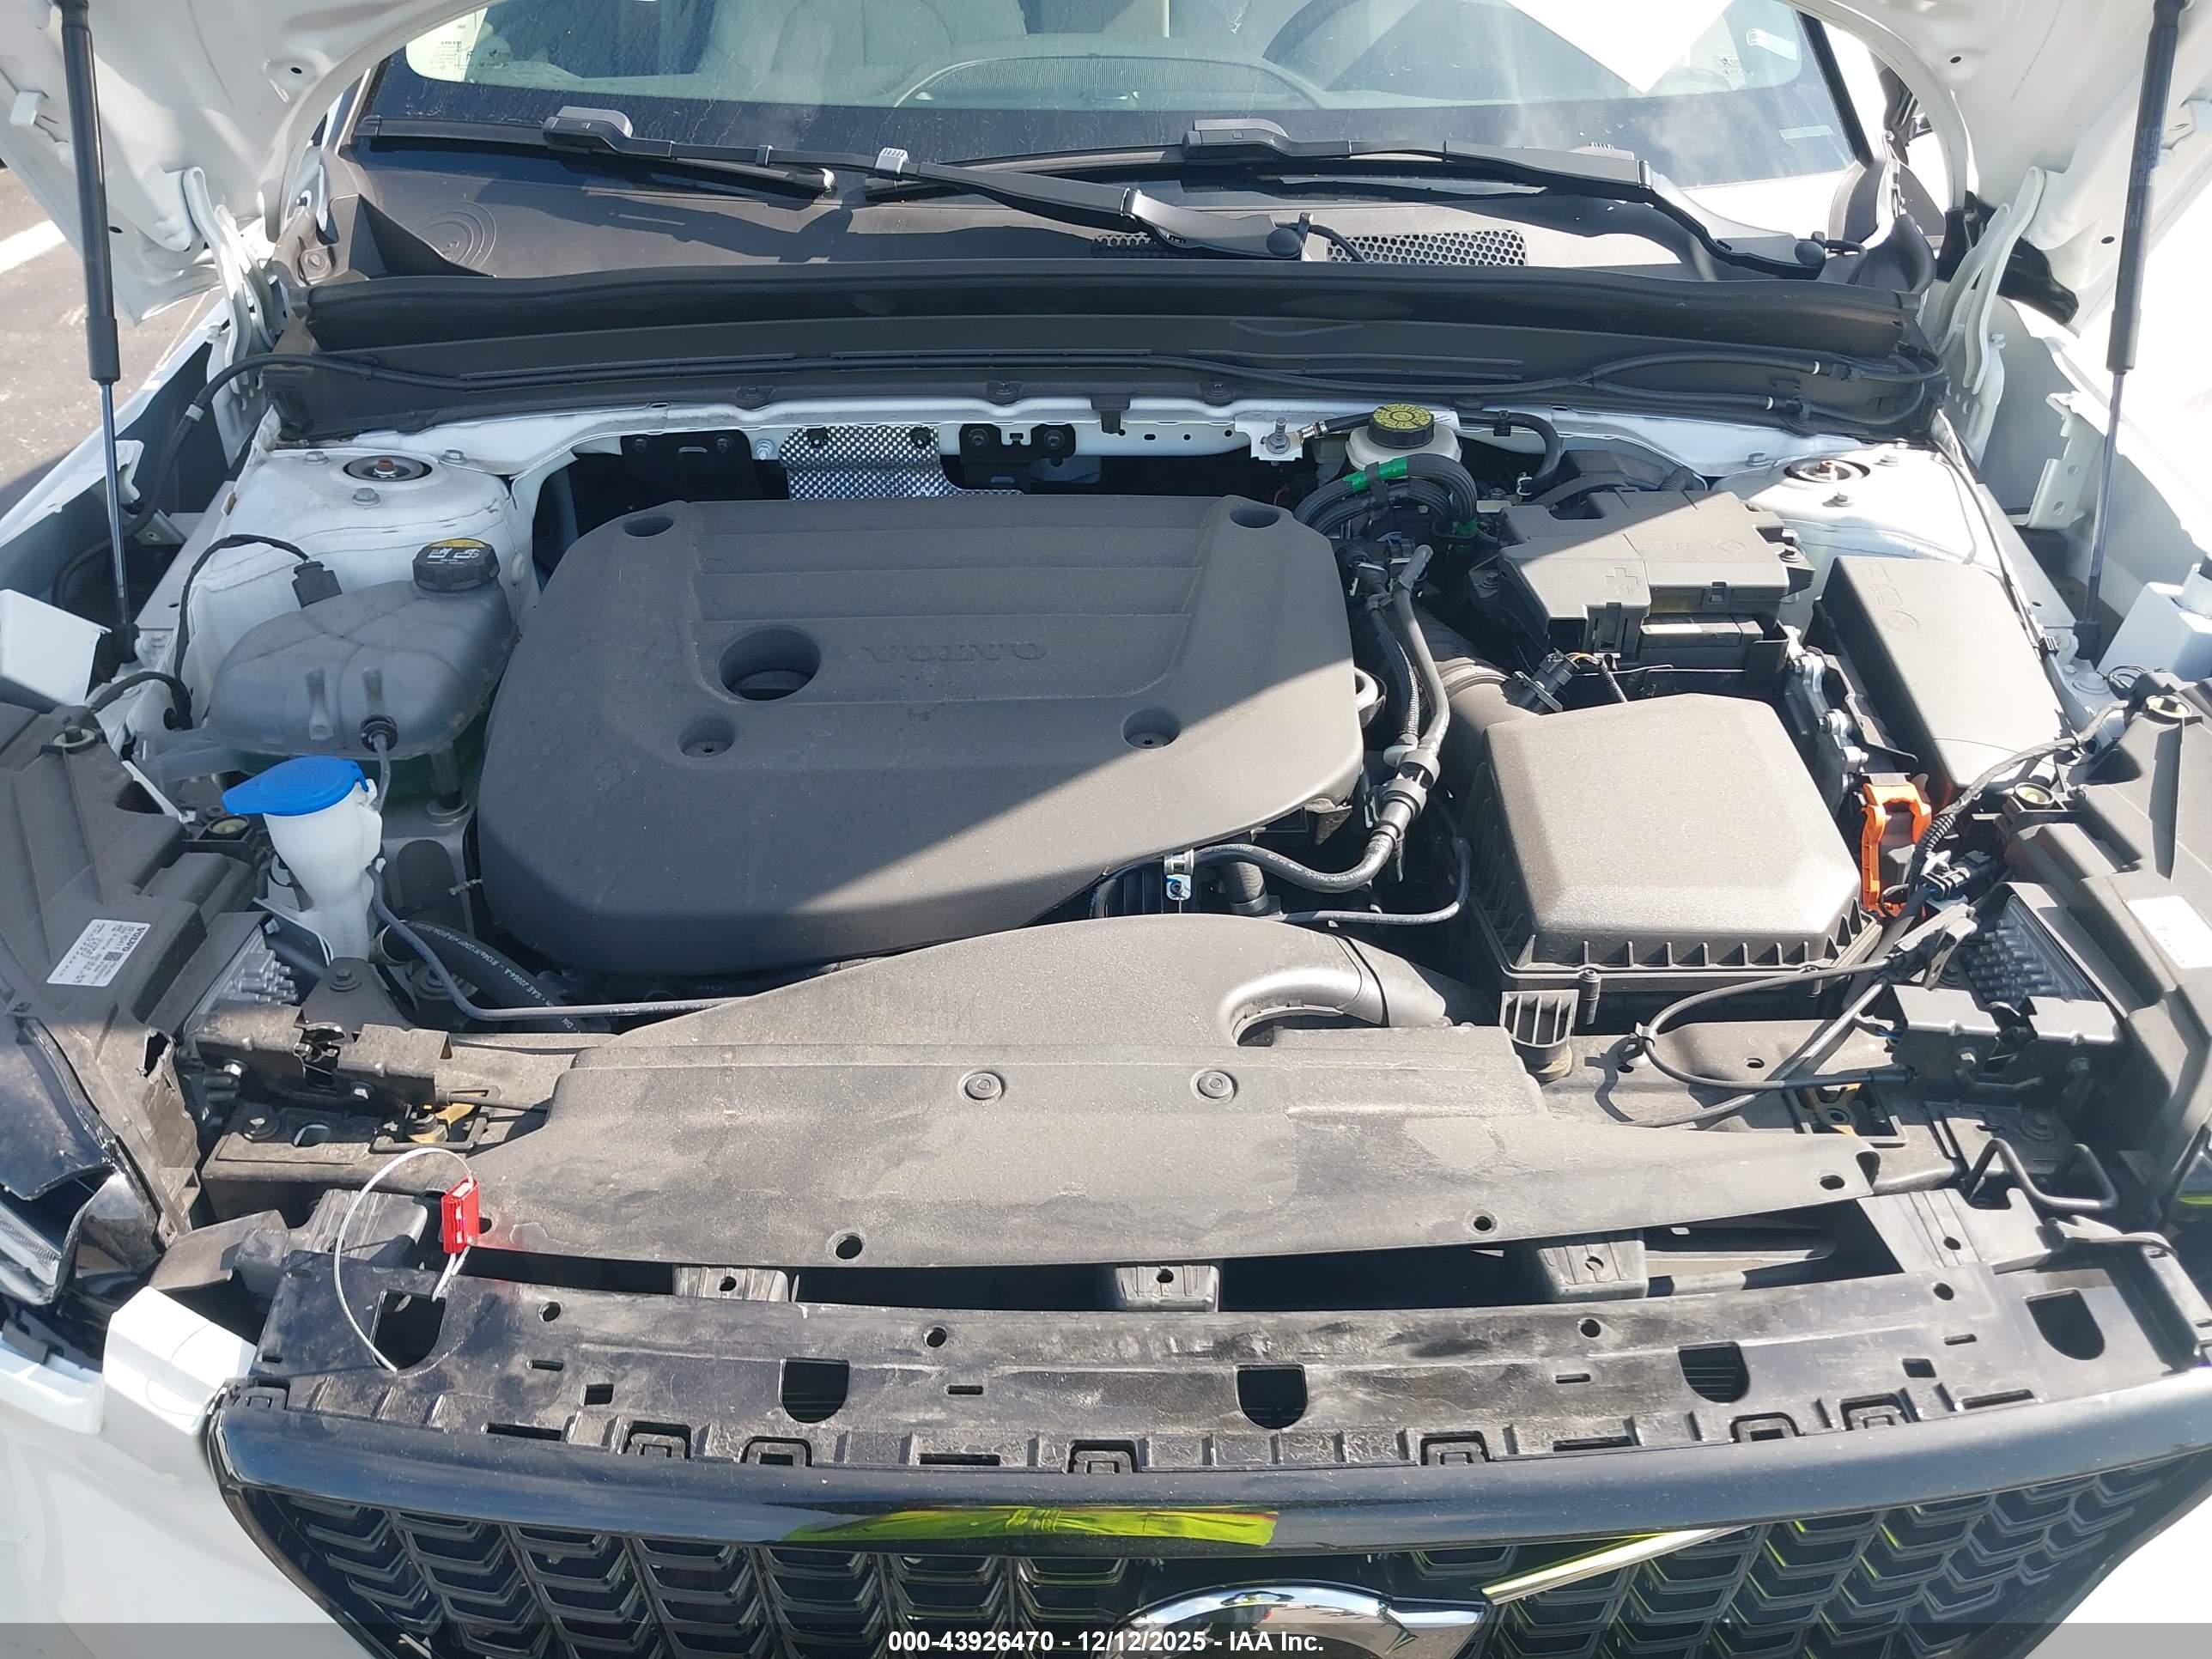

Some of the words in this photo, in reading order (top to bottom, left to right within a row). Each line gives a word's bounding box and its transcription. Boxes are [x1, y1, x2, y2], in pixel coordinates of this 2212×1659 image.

[861, 643, 1047, 664] VOLVO
[122, 926, 146, 952] VOLVO
[526, 985, 544, 1000] SAE
